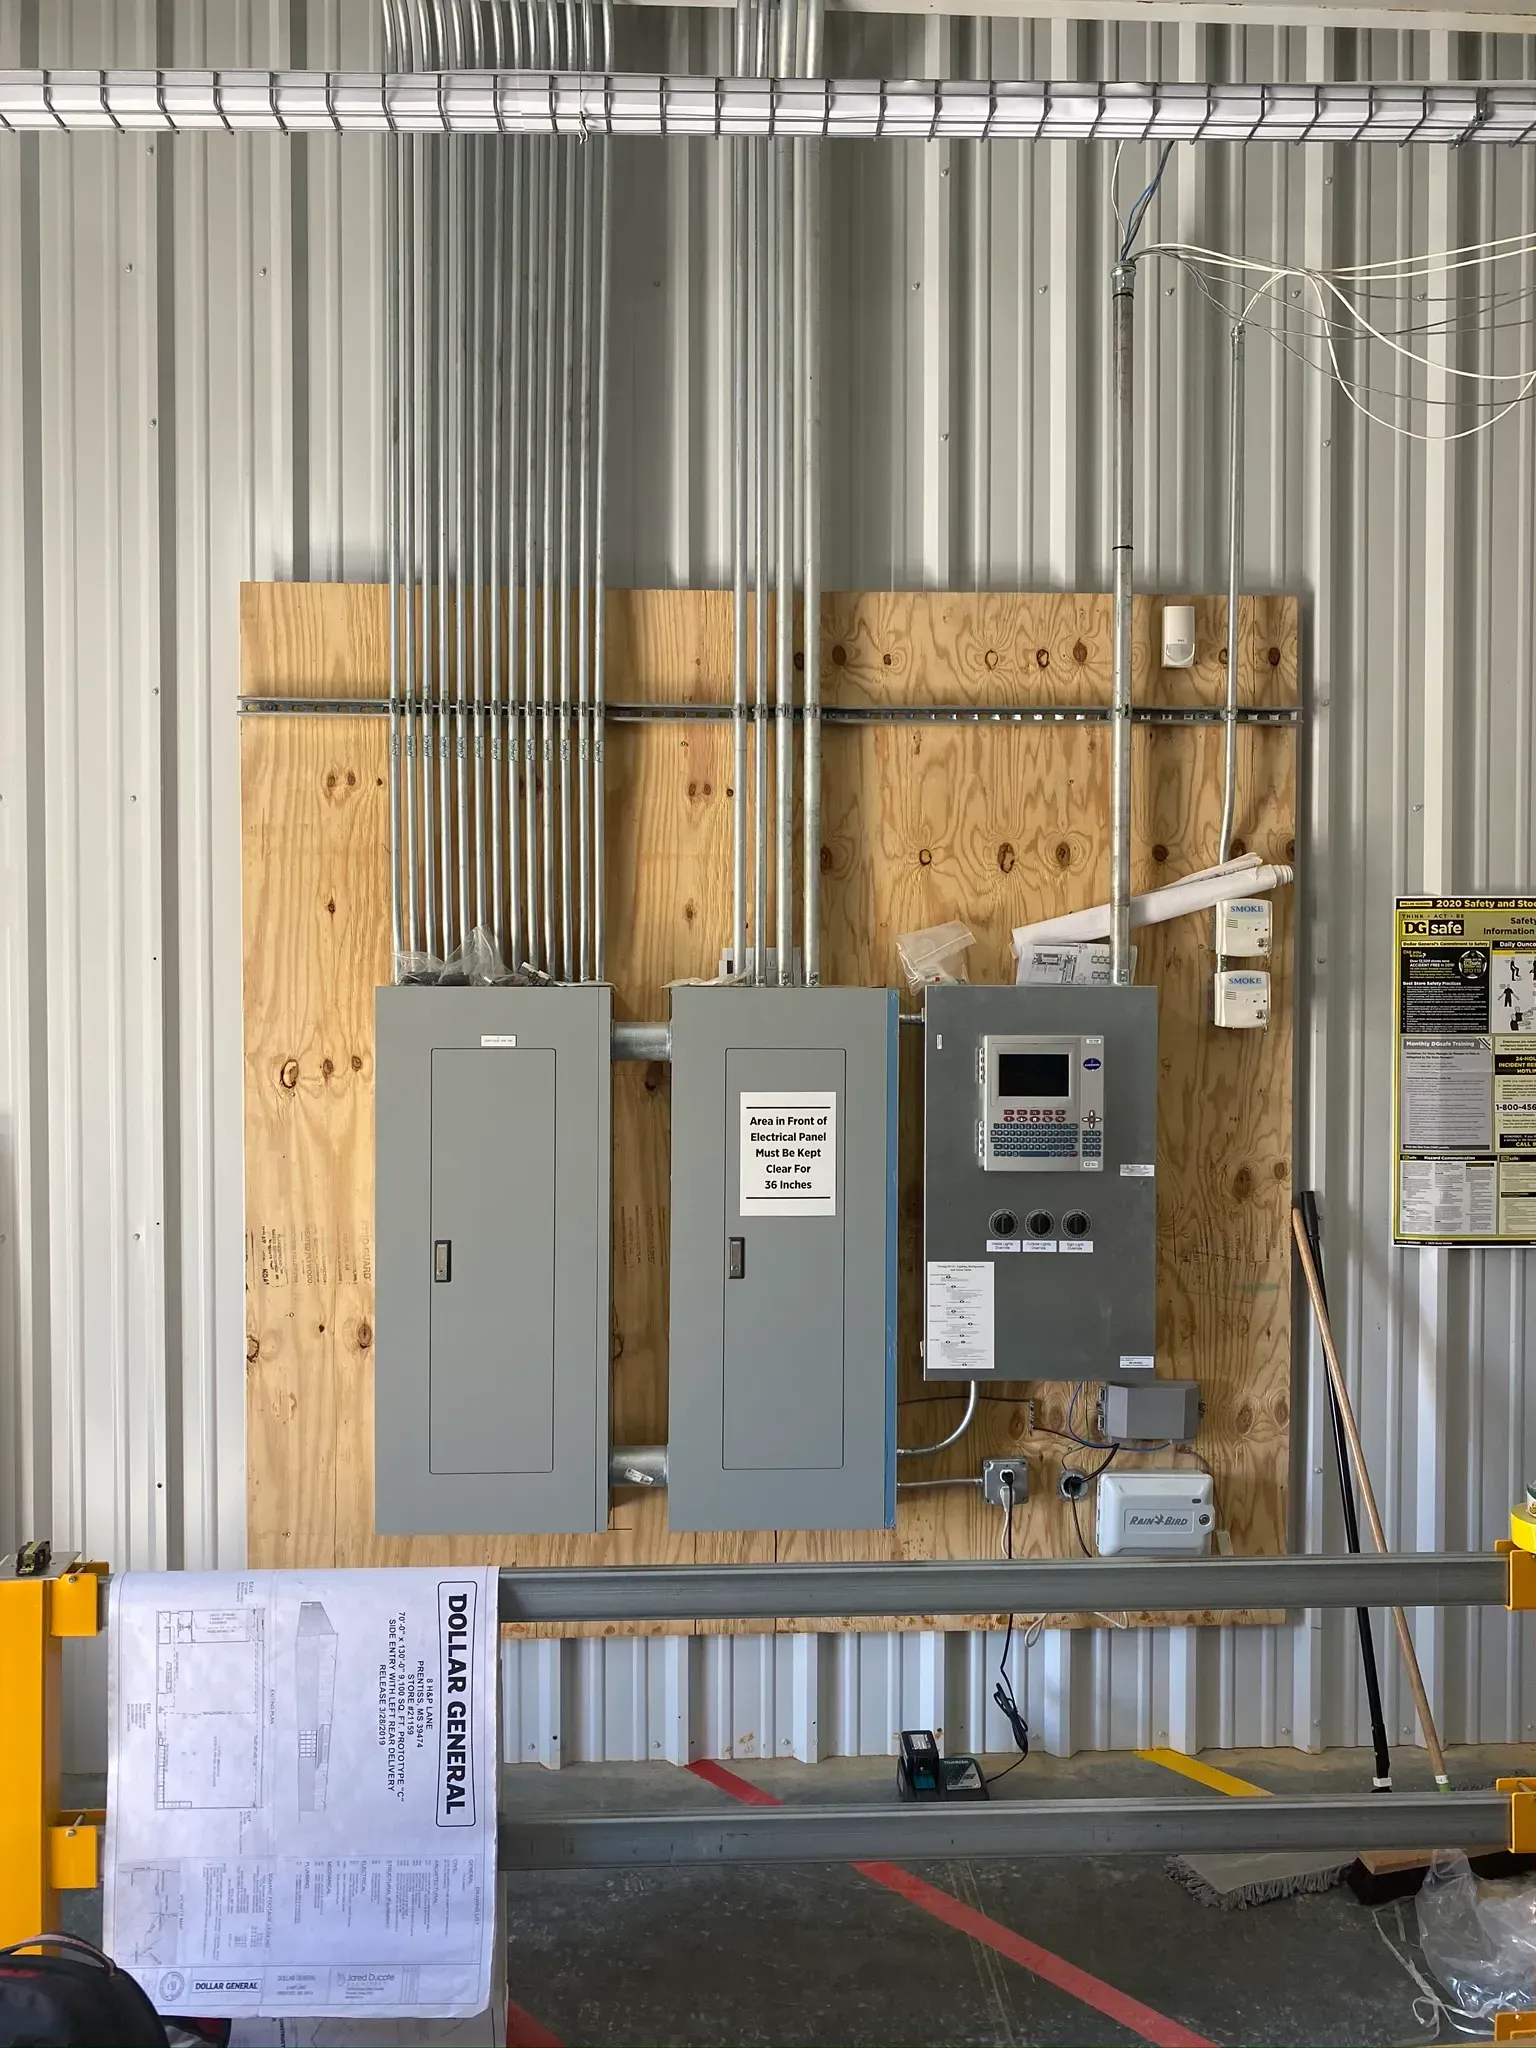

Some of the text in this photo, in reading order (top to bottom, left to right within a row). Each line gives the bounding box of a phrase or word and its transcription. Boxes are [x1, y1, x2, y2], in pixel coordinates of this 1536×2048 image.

[1464, 900, 1495, 908] Safety
[1404, 921, 1462, 934] DG safe
[749, 1116, 828, 1126] Area in Front of
[750, 1132, 826, 1141] Electrical Panel
[756, 1149, 821, 1158] Must Be Kept
[766, 1164, 811, 1173] Clear For
[765, 1180, 812, 1189] 36 Inches
[1129, 1516, 1188, 1525] RAIN BIRD
[446, 1594, 467, 1814] DOLLAR GENERAL
[416, 1708, 424, 1721] MS
